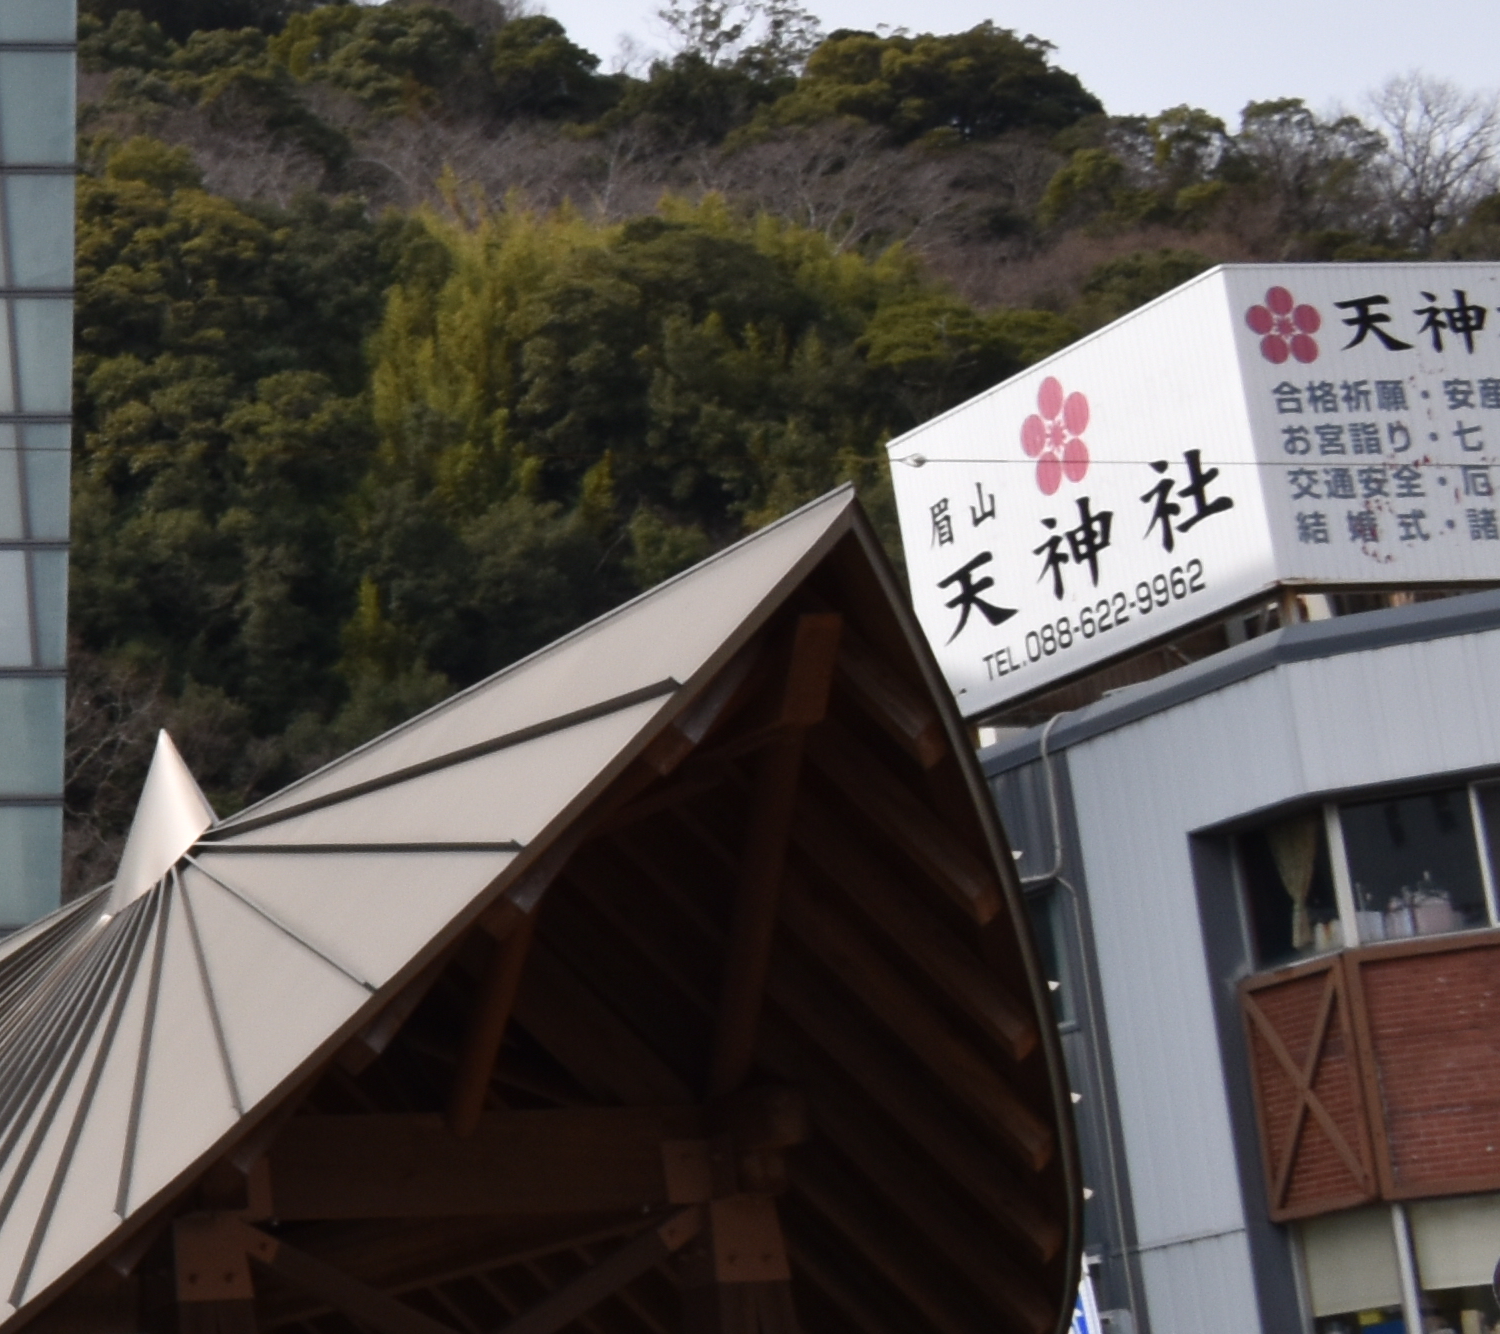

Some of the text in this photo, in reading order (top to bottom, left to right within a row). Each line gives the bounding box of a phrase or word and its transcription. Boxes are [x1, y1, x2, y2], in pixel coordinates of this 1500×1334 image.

[1333, 289, 1500, 354] 天神
[929, 482, 997, 549] 眉山
[936, 449, 1235, 648] 天神社
[981, 557, 1206, 681] TEL.088-622-9962
